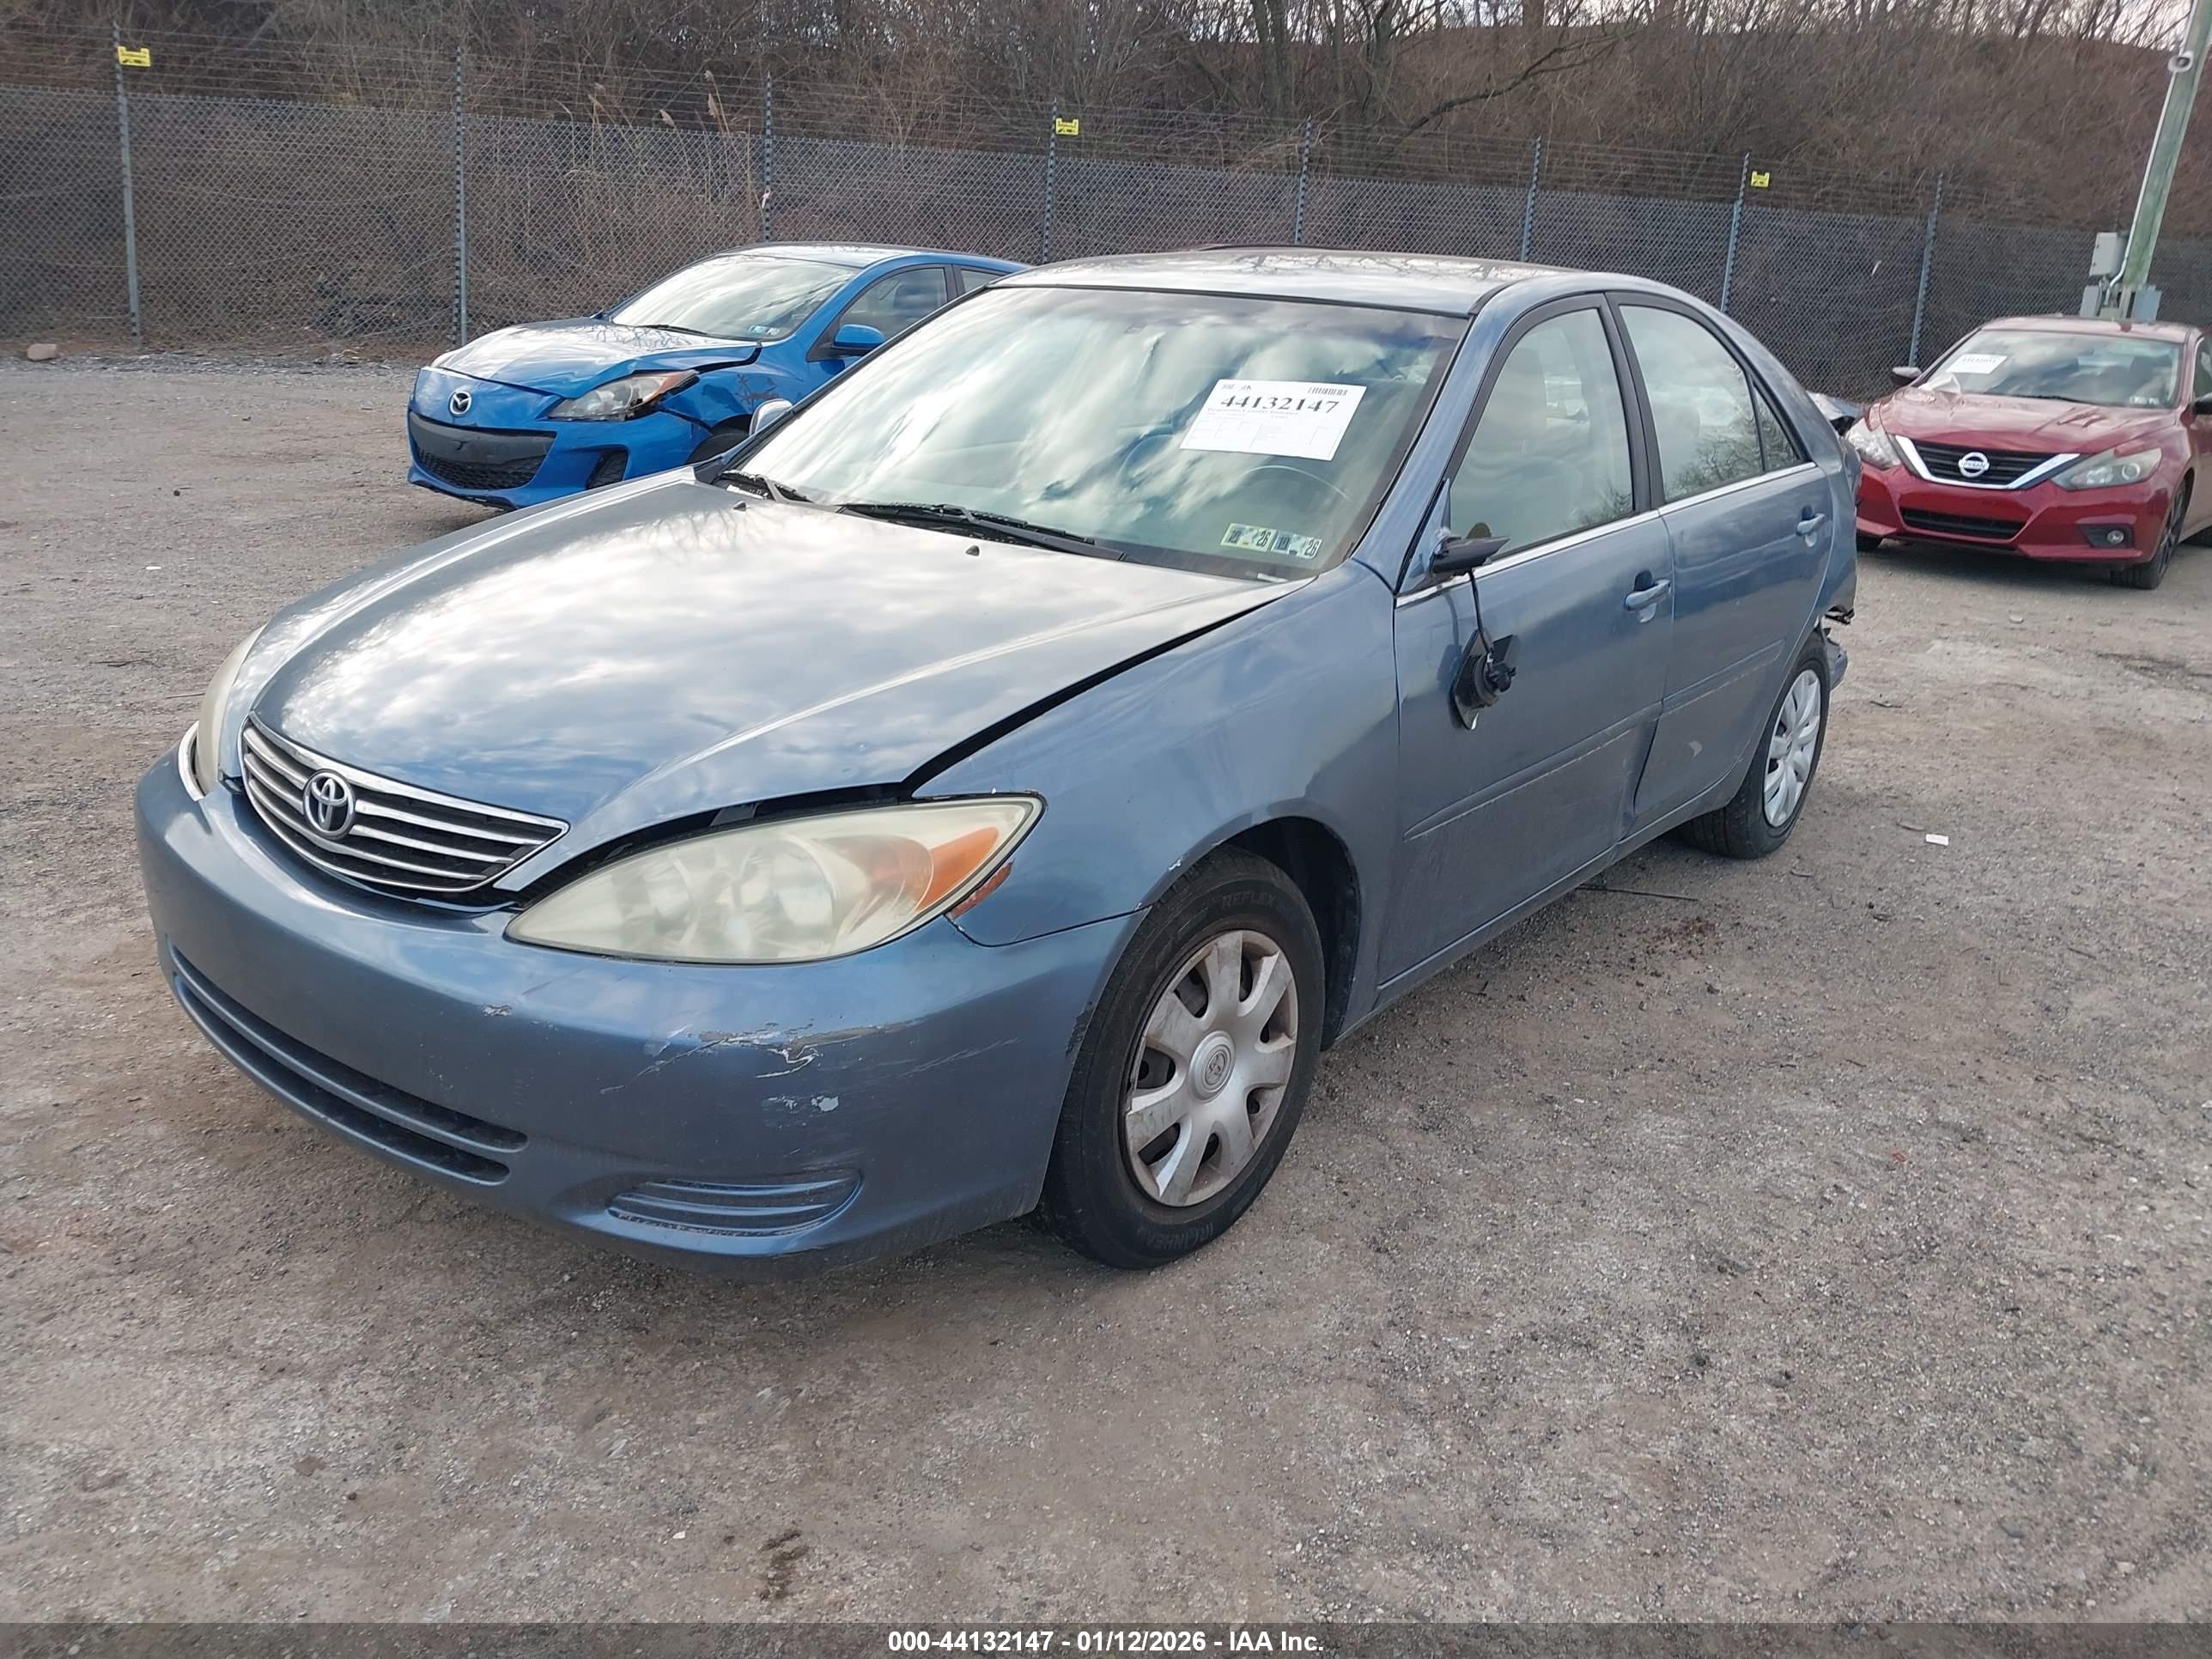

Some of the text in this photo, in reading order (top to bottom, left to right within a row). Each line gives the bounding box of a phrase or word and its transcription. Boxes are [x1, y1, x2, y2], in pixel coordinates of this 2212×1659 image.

[1220, 394, 1340, 413] 44132147
[1255, 531, 1272, 547] 26
[1304, 538, 1320, 556] 26
